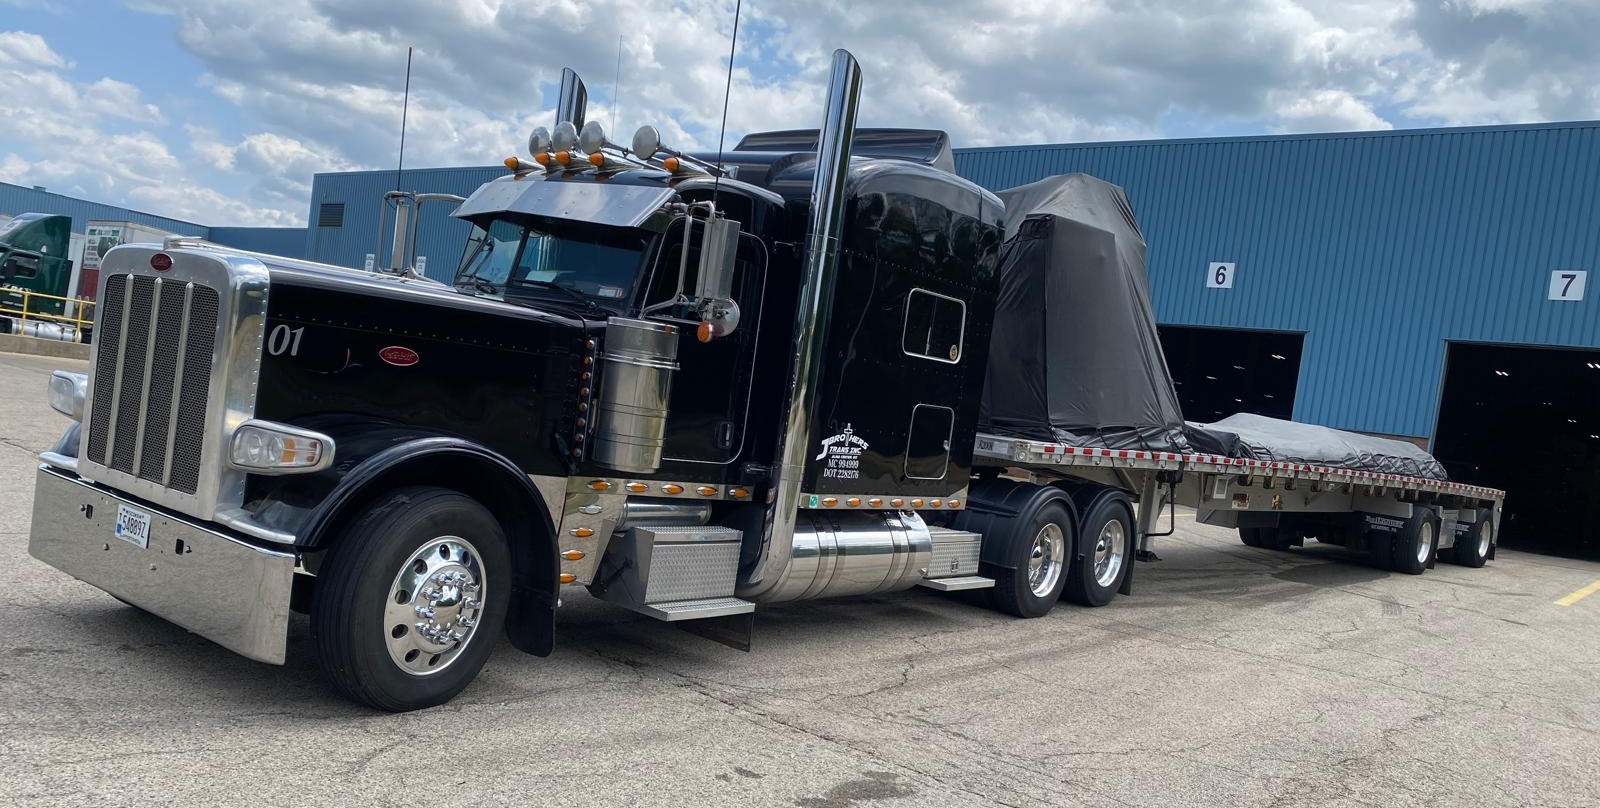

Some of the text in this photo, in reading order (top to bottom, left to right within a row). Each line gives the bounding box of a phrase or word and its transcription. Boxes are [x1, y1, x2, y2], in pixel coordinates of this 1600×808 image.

[1215, 265, 1227, 285] 6
[1561, 274, 1577, 297] 7
[268, 324, 305, 356] 01
[829, 445, 850, 454] TRANS
[827, 458, 838, 468] MC
[823, 468, 837, 478] DOT
